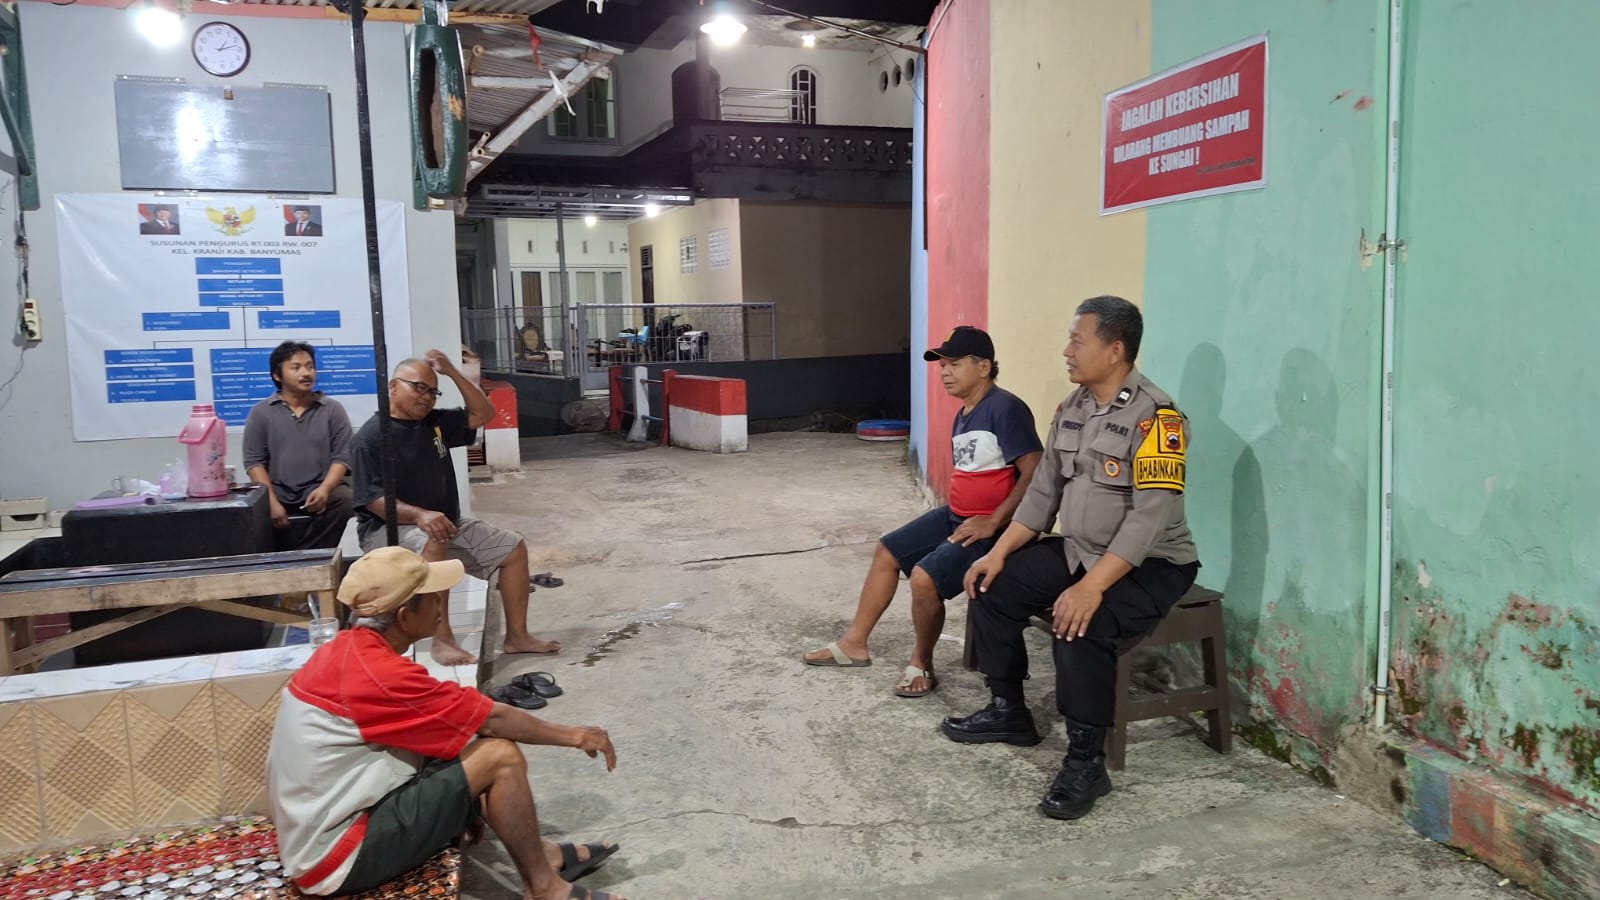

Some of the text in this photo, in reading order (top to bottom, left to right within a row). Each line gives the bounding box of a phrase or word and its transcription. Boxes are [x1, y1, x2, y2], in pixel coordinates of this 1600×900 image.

[1121, 72, 1240, 132] JAGALAH KEBERSIHAN
[1113, 109, 1250, 163] DILARANG MEMBUANG SAMPAH
[1148, 156, 1160, 176] KE
[1161, 148, 1195, 172] SUNGAI
[1104, 422, 1129, 437] POLRI
